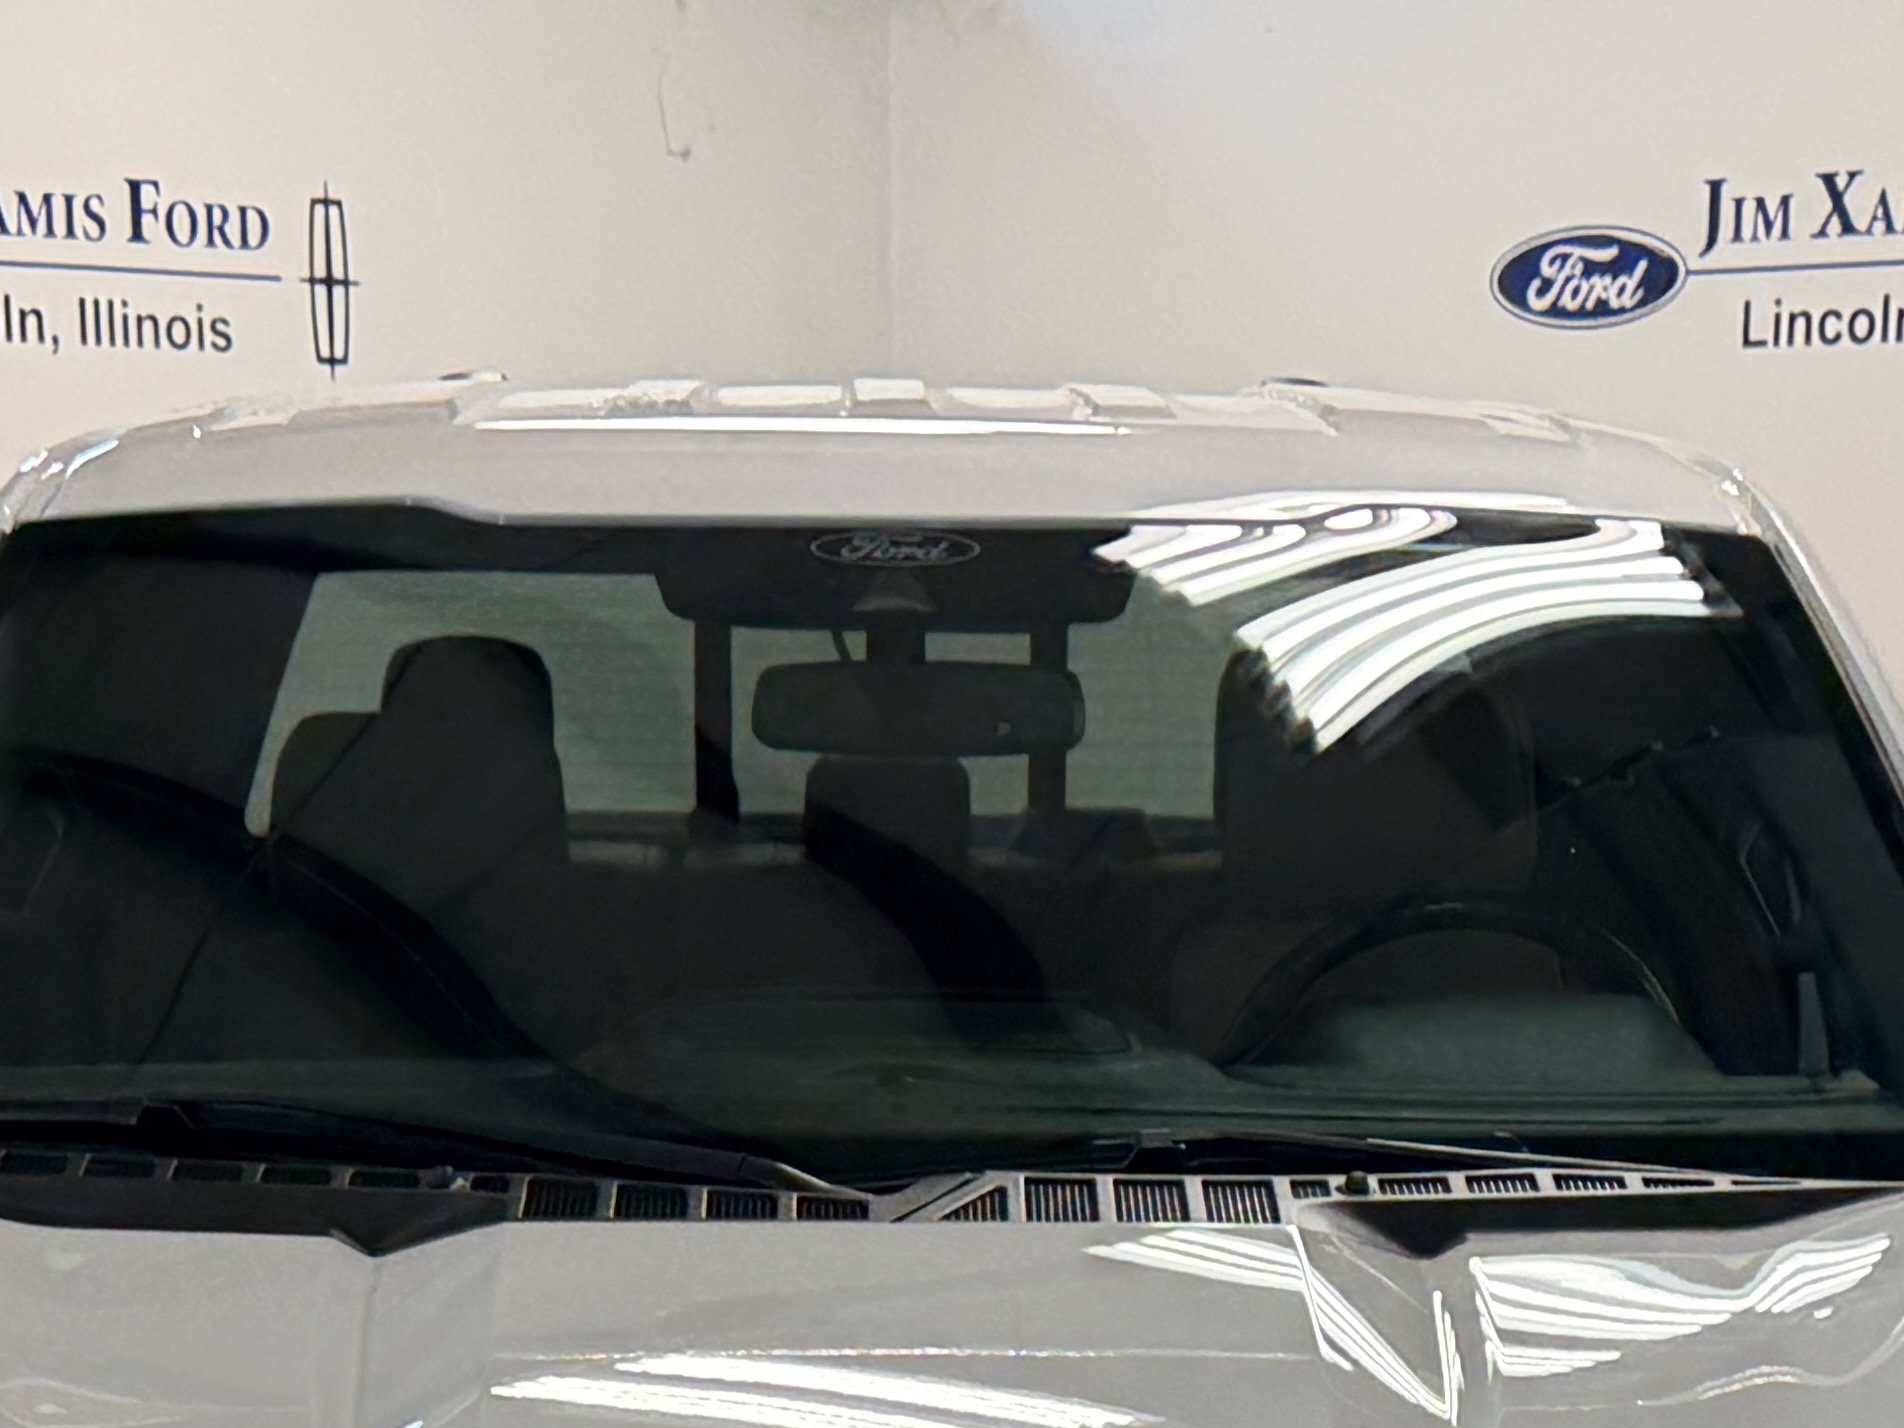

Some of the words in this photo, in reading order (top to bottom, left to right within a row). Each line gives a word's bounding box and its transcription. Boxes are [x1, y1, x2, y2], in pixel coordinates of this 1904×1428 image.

[123, 177, 270, 250] FORD
[1698, 178, 1794, 258] JIM
[1527, 242, 1649, 315] Ford
[78, 296, 234, 354] Illinois
[841, 531, 949, 561] Ford
